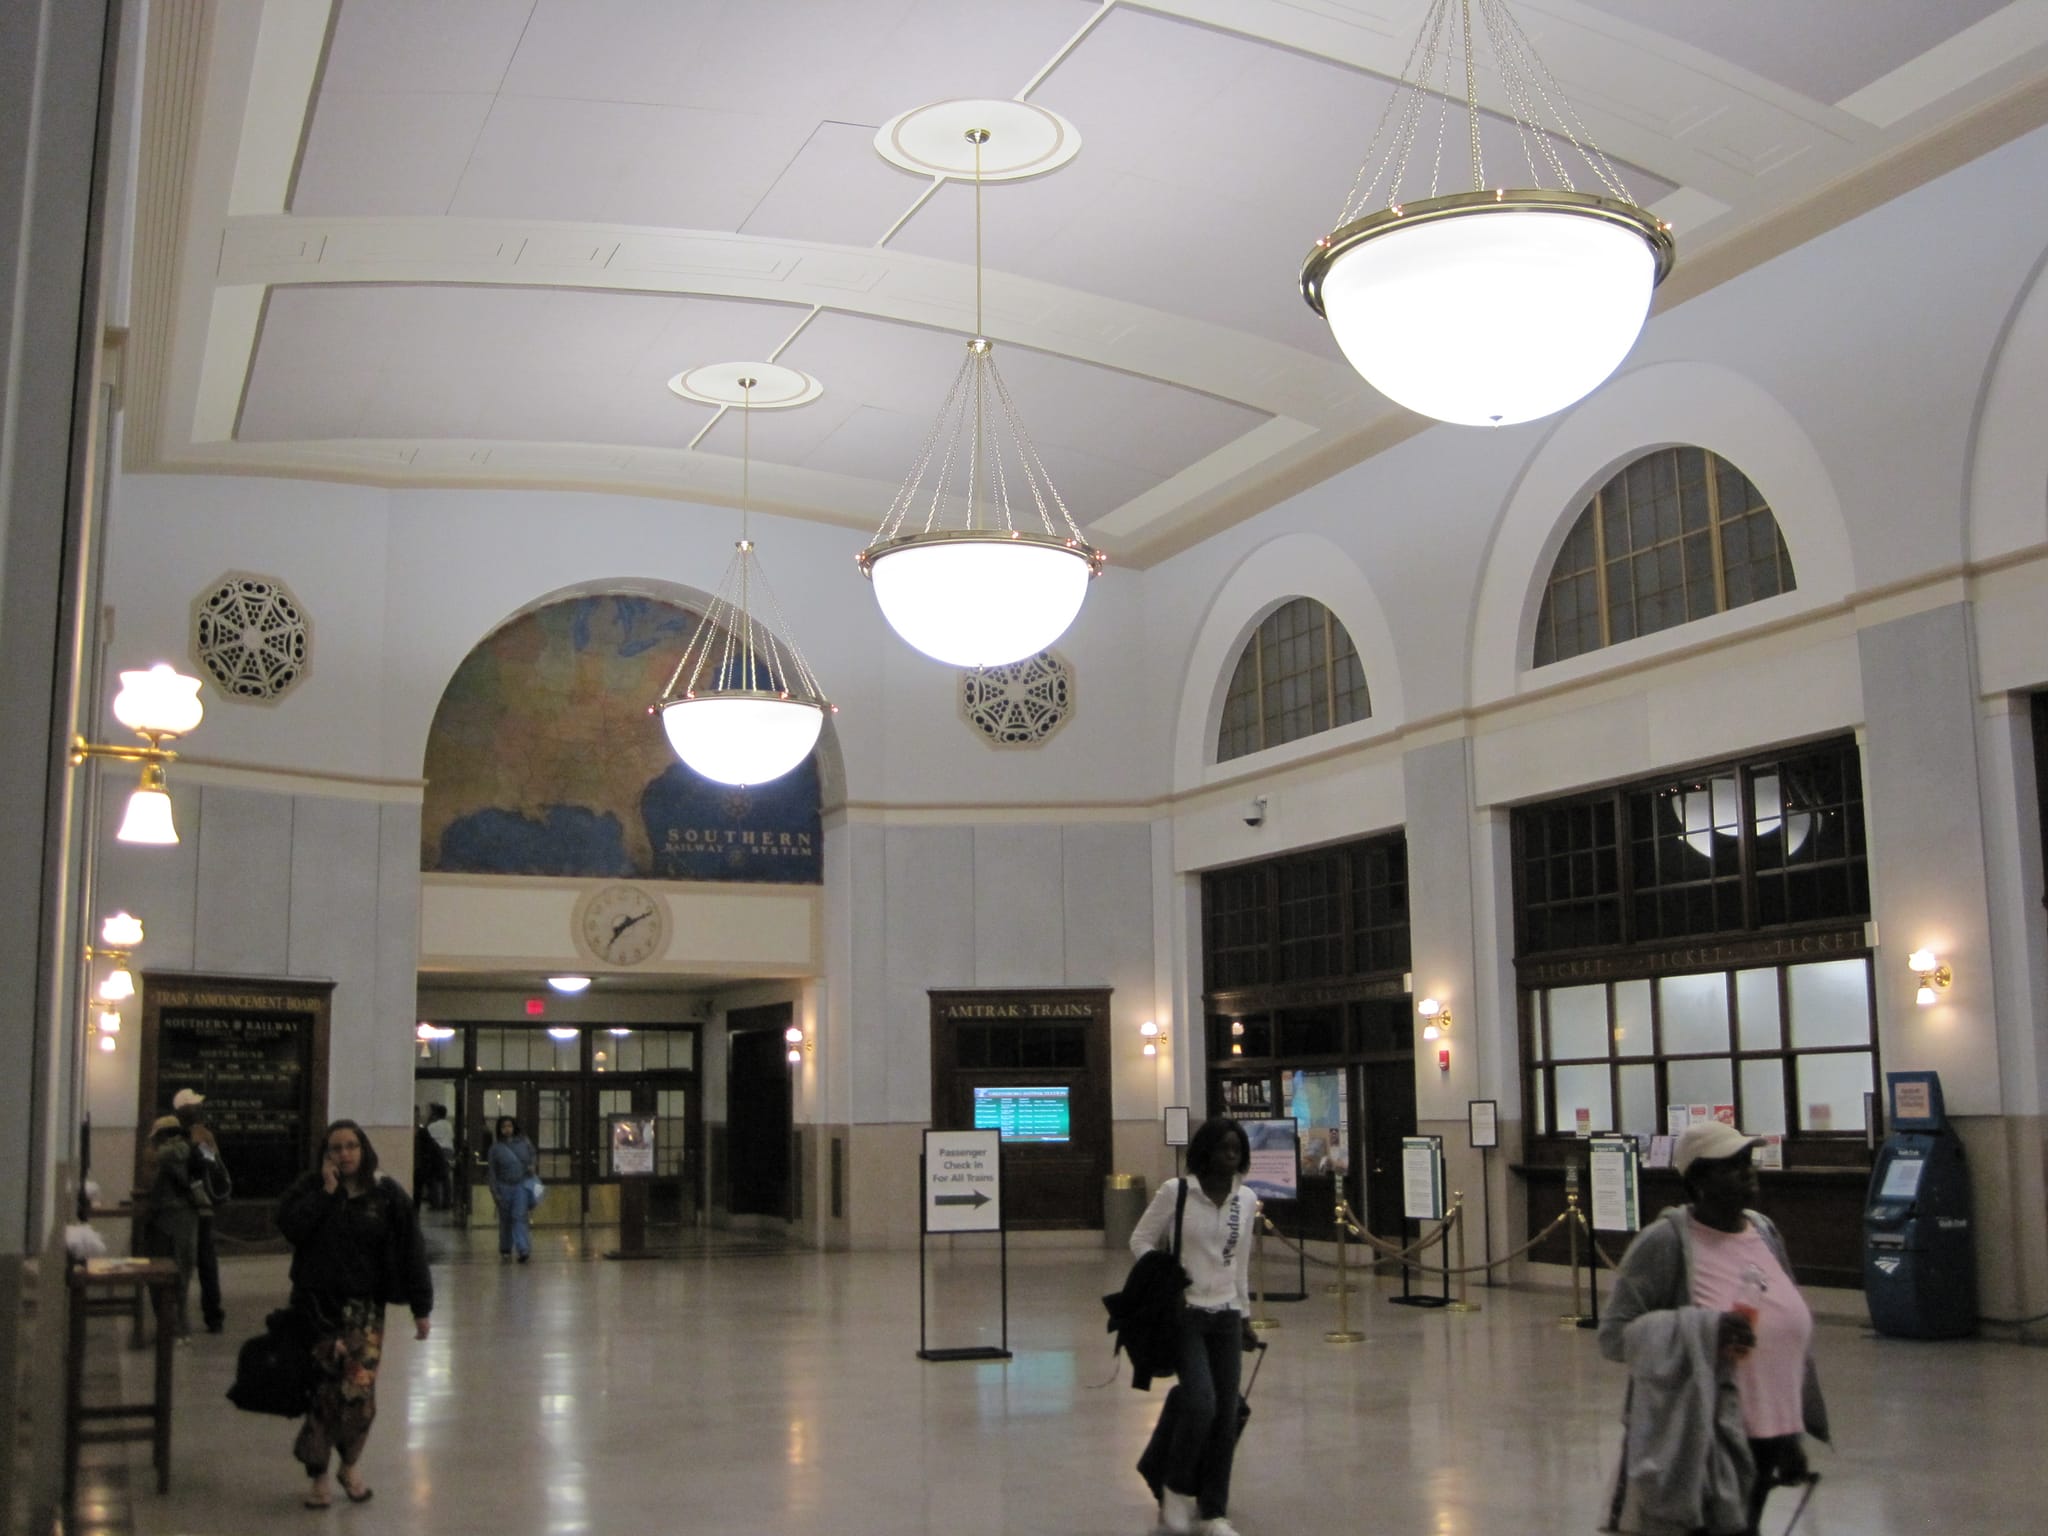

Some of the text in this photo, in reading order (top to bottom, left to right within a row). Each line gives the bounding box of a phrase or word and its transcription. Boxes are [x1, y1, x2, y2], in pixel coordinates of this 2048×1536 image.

[667, 828, 812, 846] SOUTHERN
[665, 842, 813, 857] RAILWAY SYSTEM
[1537, 931, 1859, 977] TICKET TICKET TICKET
[157, 992, 321, 1012] TRAIN ANNOUNCEMENT BOARD
[947, 1004, 1093, 1018] AMTRAK TRAINS
[164, 1018, 299, 1033] SOUTHERN RAILWAY
[939, 1148, 988, 1159] Passenger
[943, 1160, 971, 1170] Check
[932, 1174, 995, 1183] For All Trains
